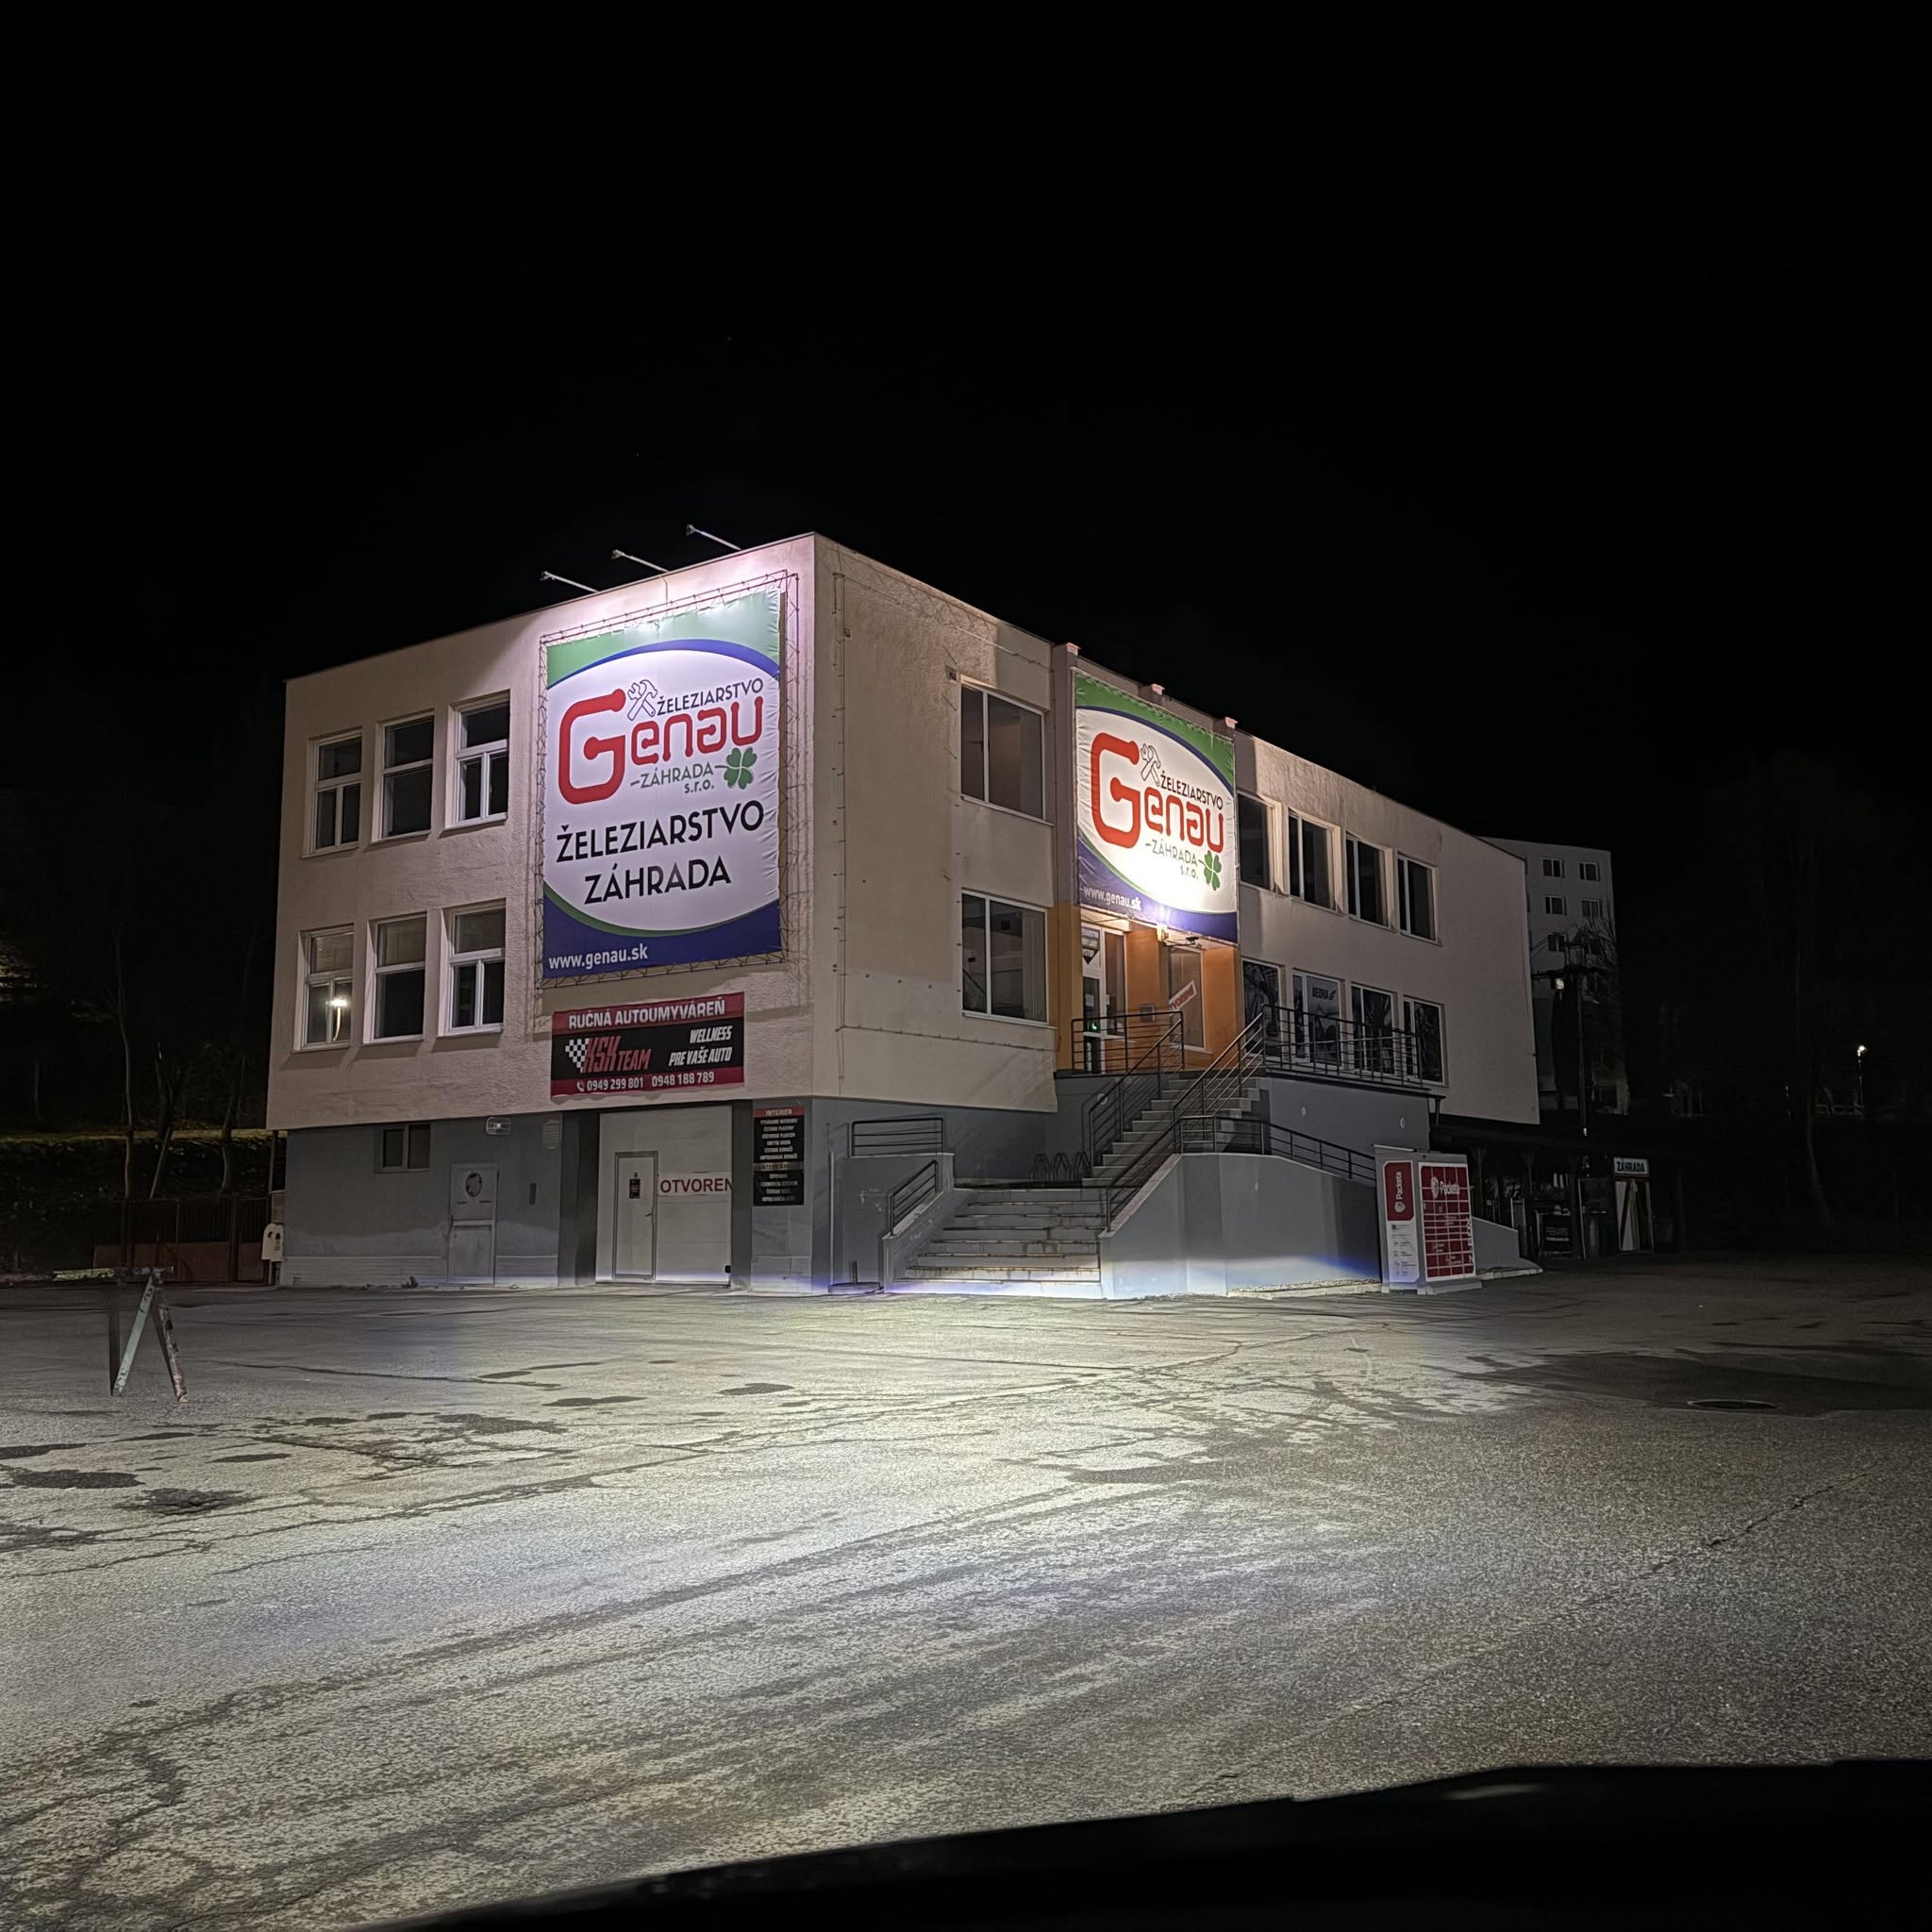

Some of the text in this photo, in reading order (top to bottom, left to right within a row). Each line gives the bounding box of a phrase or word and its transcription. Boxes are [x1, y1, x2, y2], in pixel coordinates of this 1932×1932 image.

[657, 677, 763, 717] ŽELEZIARSTVO
[558, 688, 764, 805] Genau
[684, 781, 715, 794] s.r.o.
[1091, 732, 1224, 854] Genau
[1160, 771, 1224, 810] ŽELEZIARSTVO
[556, 799, 764, 863] ŽELEZIARSTVO
[584, 855, 731, 906] ZÁHRADA
[1083, 887, 1141, 912] www.genau.sk
[548, 943, 648, 971] www.genau.sk
[569, 997, 725, 1030] RUČNÁ AUTOUMYVÁREŇ
[690, 1025, 733, 1044] WELLNESS
[618, 1049, 652, 1072] TEAM
[669, 1045, 733, 1067] PRE VAŠE AUTO
[587, 1072, 714, 1091] 0949 299 801 0948 188 789
[1395, 1171, 1404, 1200] Packeta
[1440, 1180, 1460, 1195] Packeta
